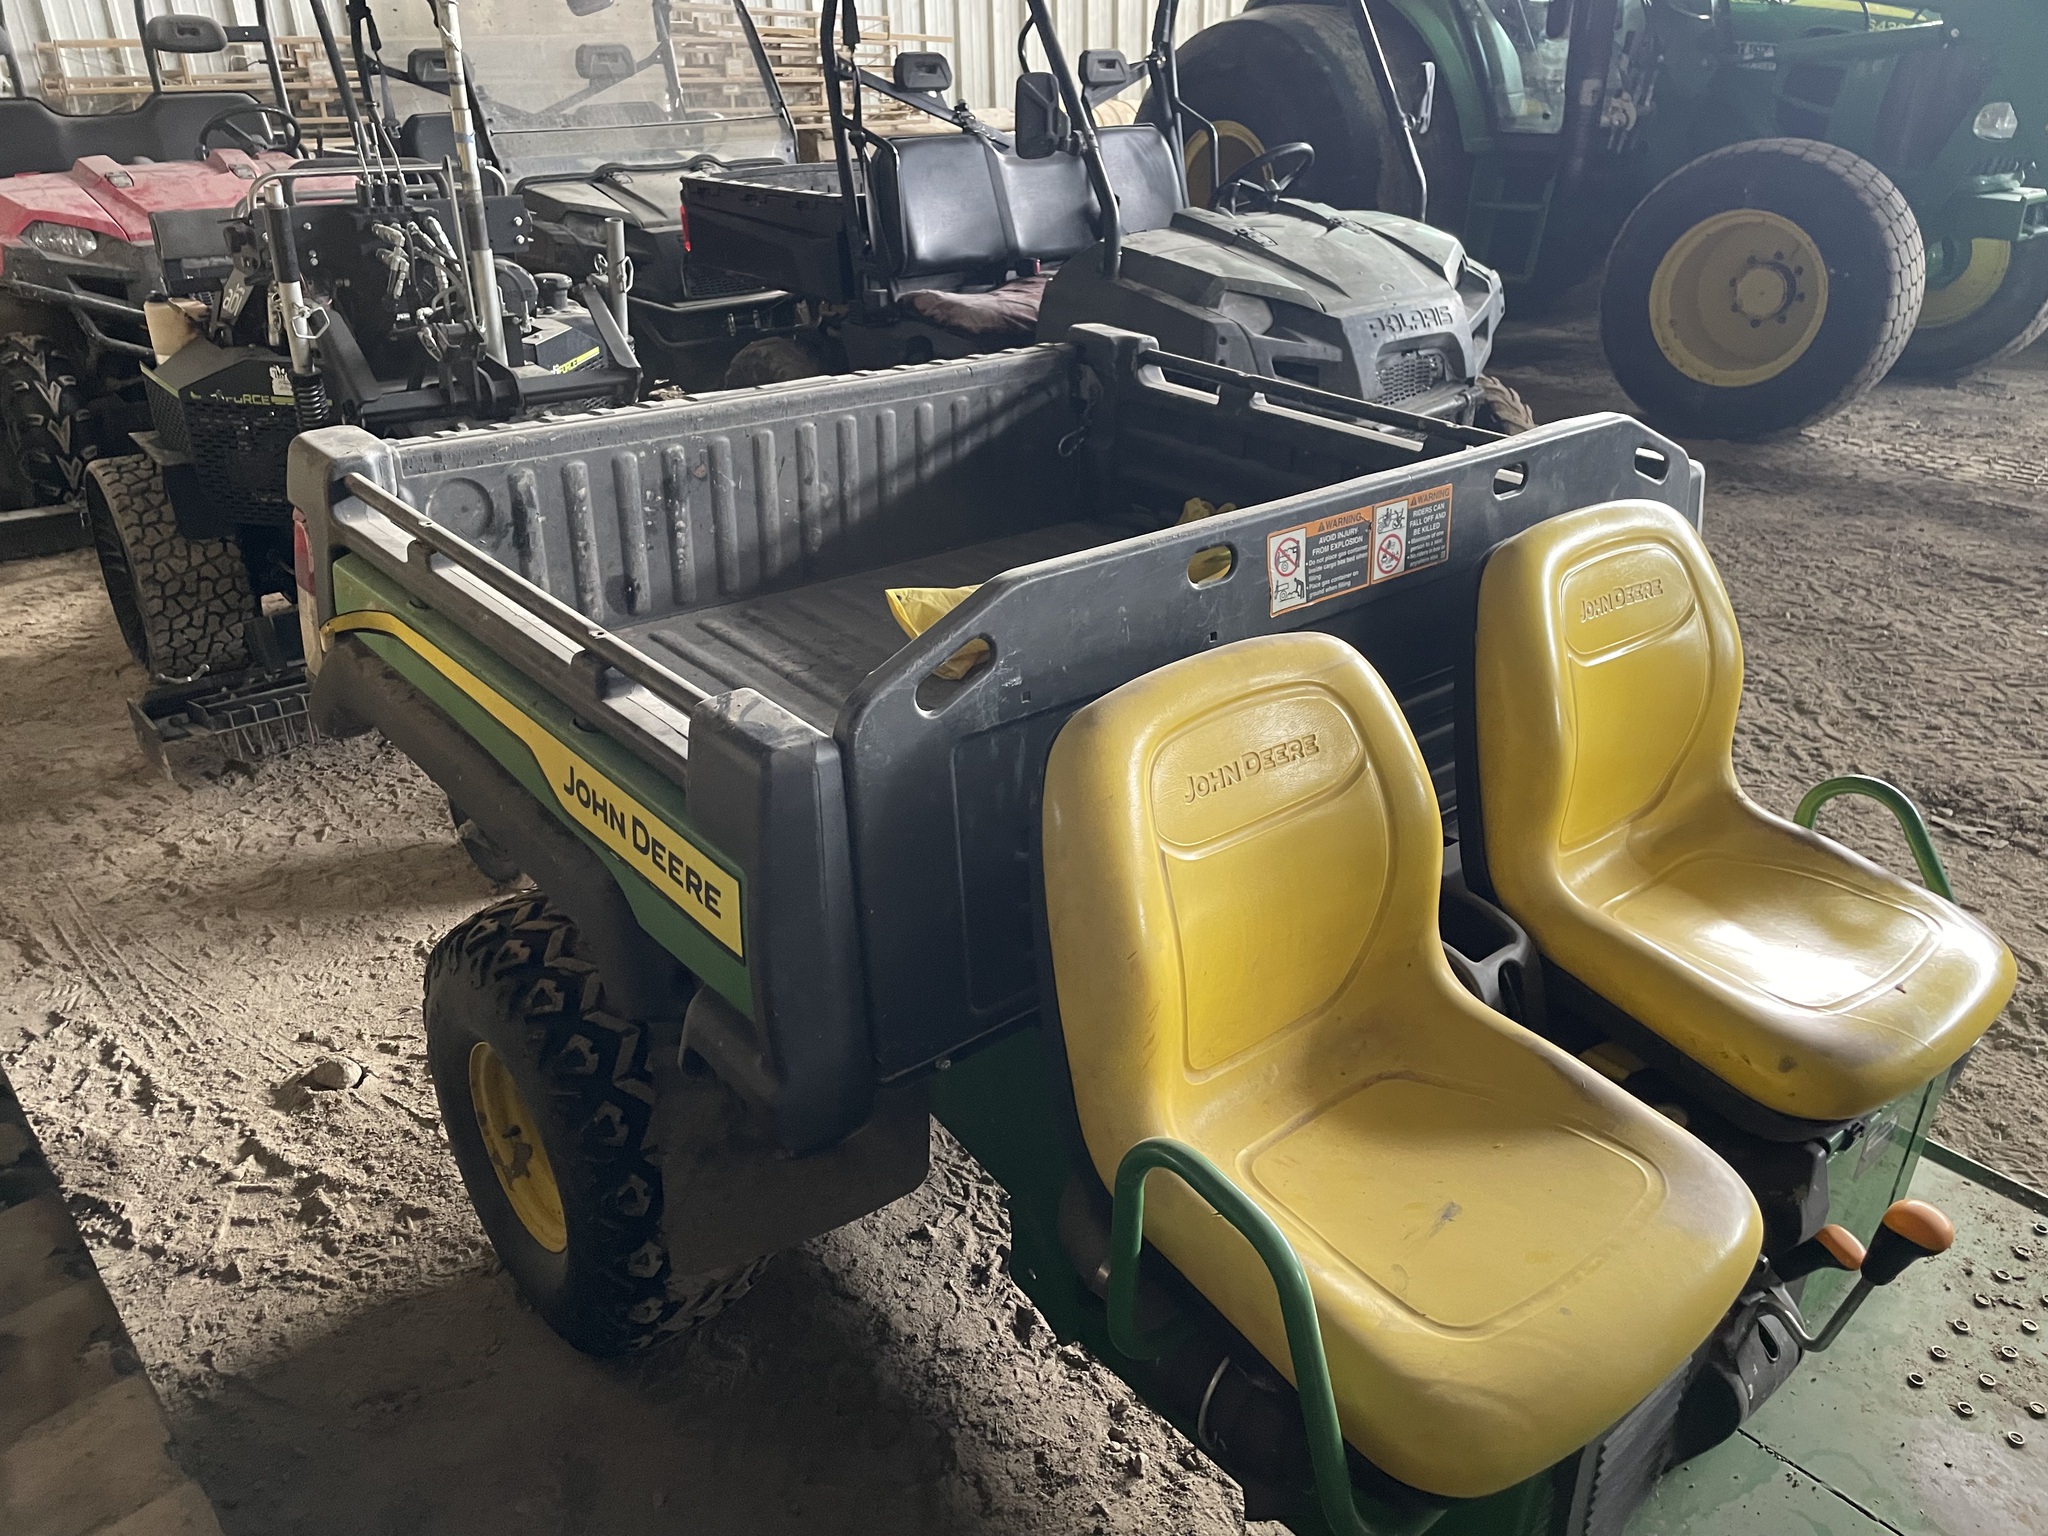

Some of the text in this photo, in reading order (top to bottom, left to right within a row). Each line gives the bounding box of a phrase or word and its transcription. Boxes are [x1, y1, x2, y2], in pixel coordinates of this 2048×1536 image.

[1366, 305, 1454, 339] POLARIS
[1417, 488, 1450, 504] WARNING
[1412, 502, 1445, 518] RIDERS CAN
[1326, 512, 1362, 530] WARNING
[1409, 511, 1446, 528] FALL OFF AND
[1319, 527, 1358, 544] AVOID INJURY
[1413, 522, 1441, 536] BE KILLED
[1312, 535, 1363, 556] FROM EXPLOSION
[1580, 578, 1664, 623] JOHN DEERE
[1184, 733, 1320, 805] JOHN DEERE
[563, 765, 722, 920] JOHN DEERE
